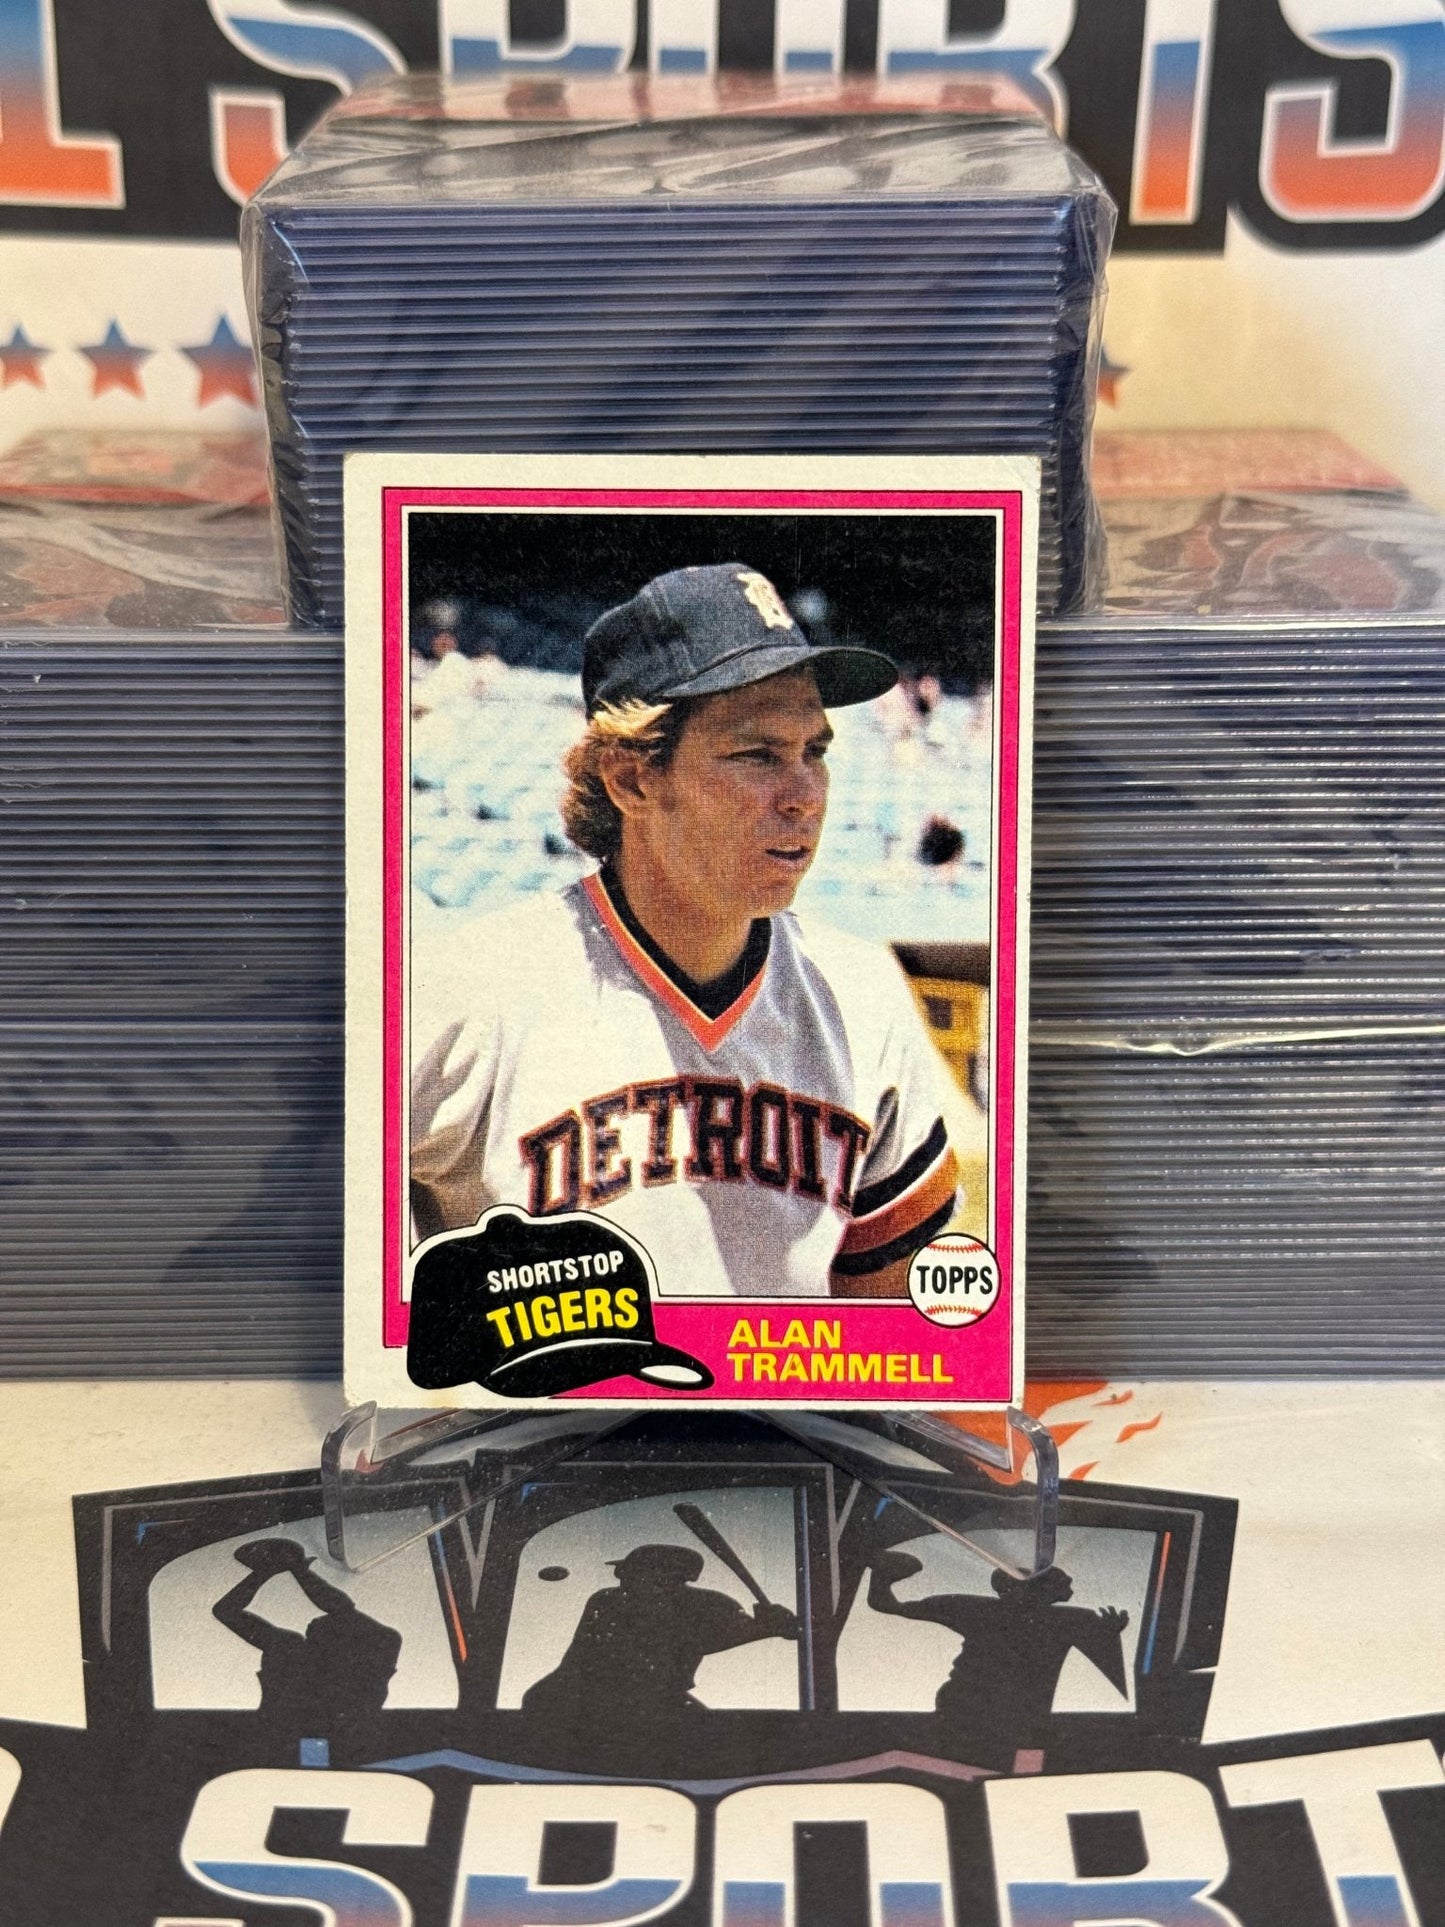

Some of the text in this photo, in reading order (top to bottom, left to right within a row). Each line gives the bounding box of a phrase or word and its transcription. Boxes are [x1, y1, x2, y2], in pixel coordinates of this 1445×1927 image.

[518, 1074, 873, 1216] DETROIT
[486, 1250, 625, 1293] SHORTSTOP
[915, 1264, 994, 1296] TOPPS
[486, 1287, 640, 1349] TIGERS
[727, 1319, 842, 1349] ALAN
[726, 1352, 954, 1384] TRAMMELL
[180, 1738, 1445, 1927] SPORT
